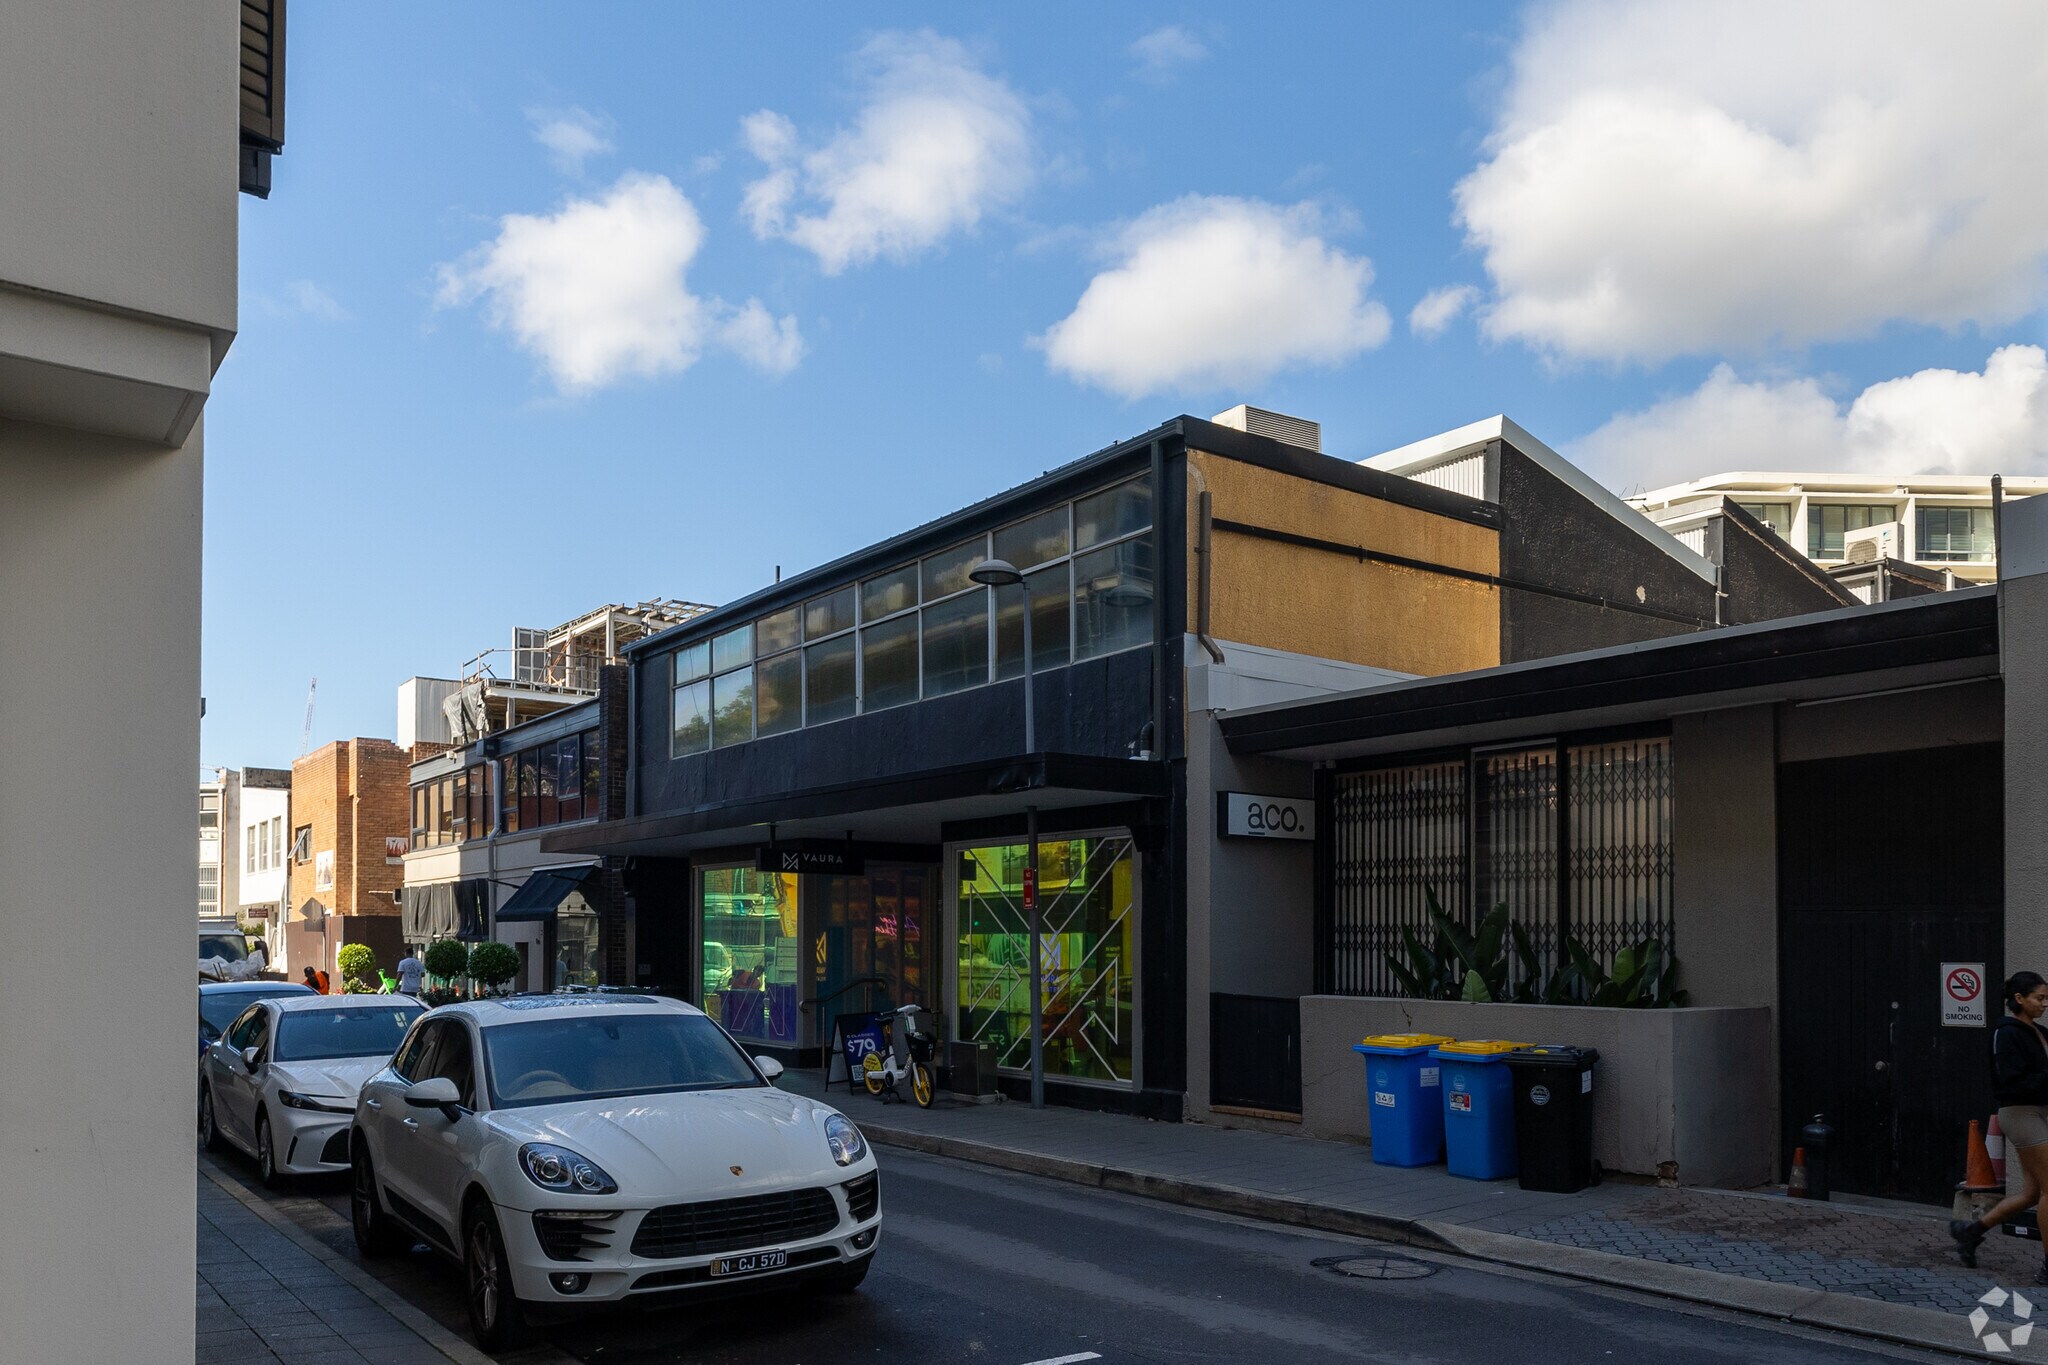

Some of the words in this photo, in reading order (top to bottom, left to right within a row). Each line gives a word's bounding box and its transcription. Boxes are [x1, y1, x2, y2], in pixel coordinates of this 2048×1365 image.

[1248, 803, 1305, 833] aco.
[802, 852, 843, 864] VAURA
[1945, 1013, 1983, 1021] SMOKING
[847, 1037, 876, 1057] $79
[721, 1260, 730, 1273] N
[739, 1257, 755, 1270] CJ
[761, 1253, 785, 1267] 57D
